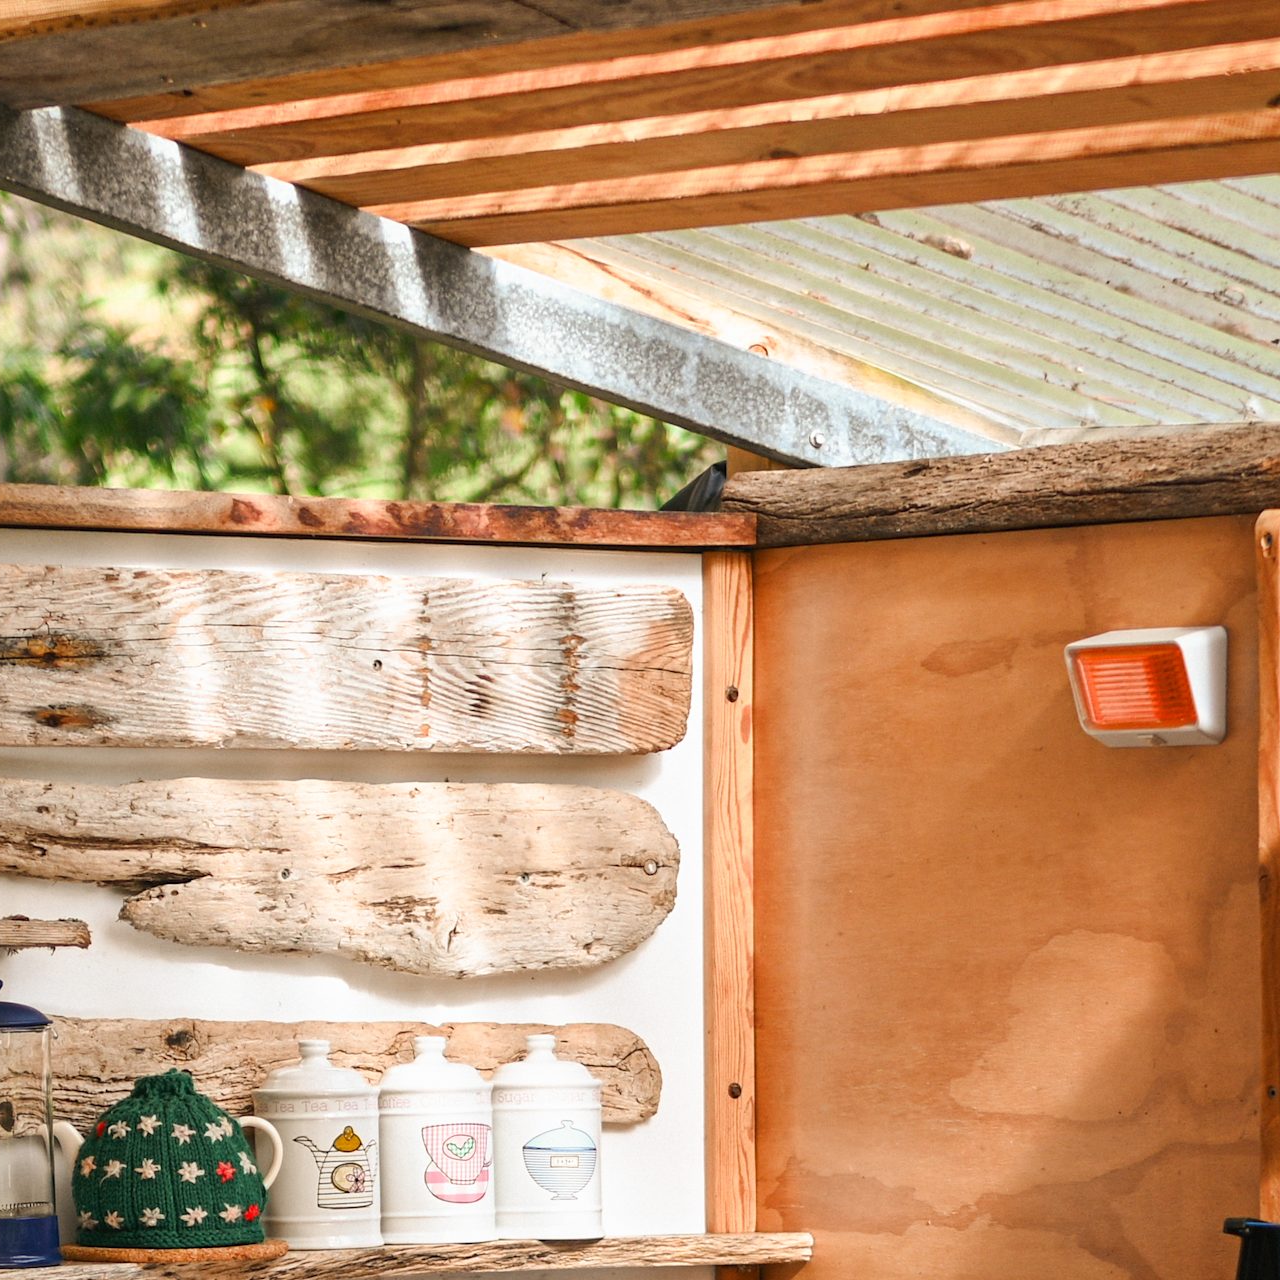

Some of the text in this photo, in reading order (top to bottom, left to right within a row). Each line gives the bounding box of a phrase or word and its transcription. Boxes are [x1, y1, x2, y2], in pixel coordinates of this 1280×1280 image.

[271, 1101, 295, 1113] Tea
[301, 1101, 328, 1112] Tea
[335, 1099, 359, 1111] Tea
